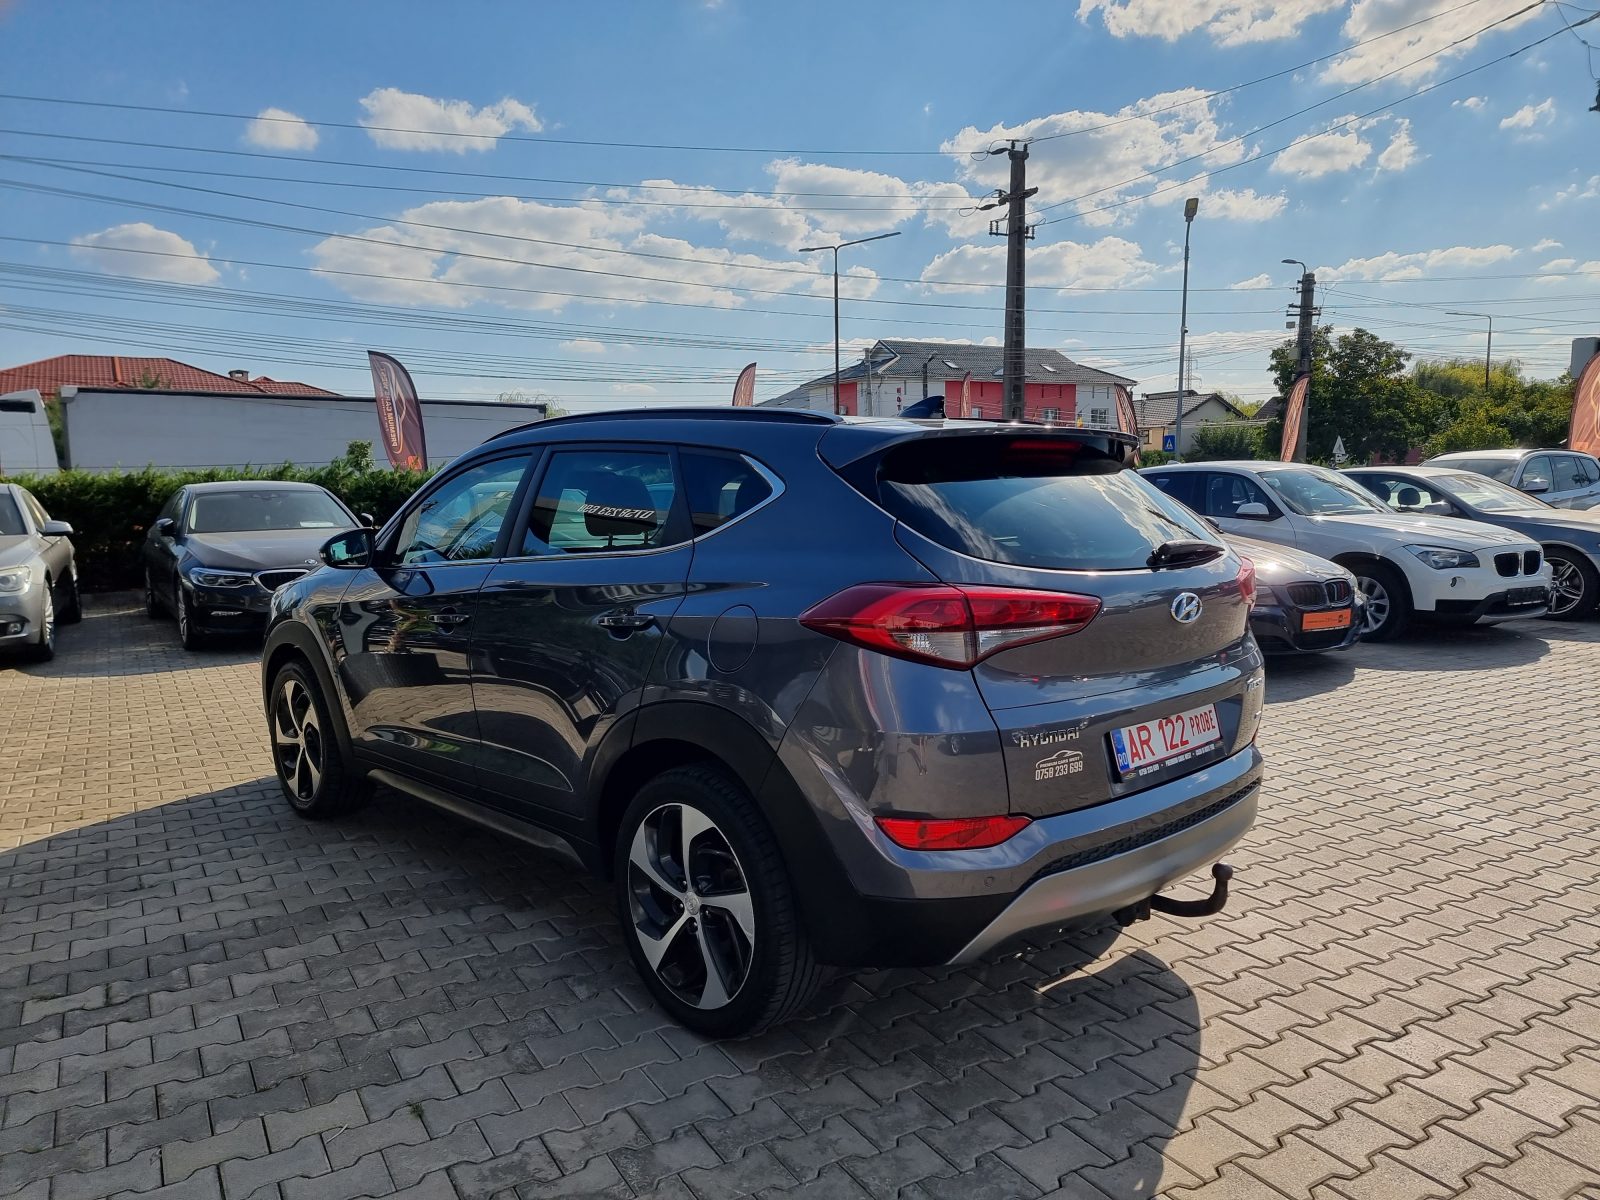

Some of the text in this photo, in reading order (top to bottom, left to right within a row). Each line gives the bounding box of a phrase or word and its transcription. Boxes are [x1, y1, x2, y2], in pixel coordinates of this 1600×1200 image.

[1020, 726, 1080, 748] HYUNDAI
[1128, 709, 1216, 764] AR 122 PROBE
[1117, 751, 1128, 767] RO
[1035, 760, 1083, 781] 0758 233 699
